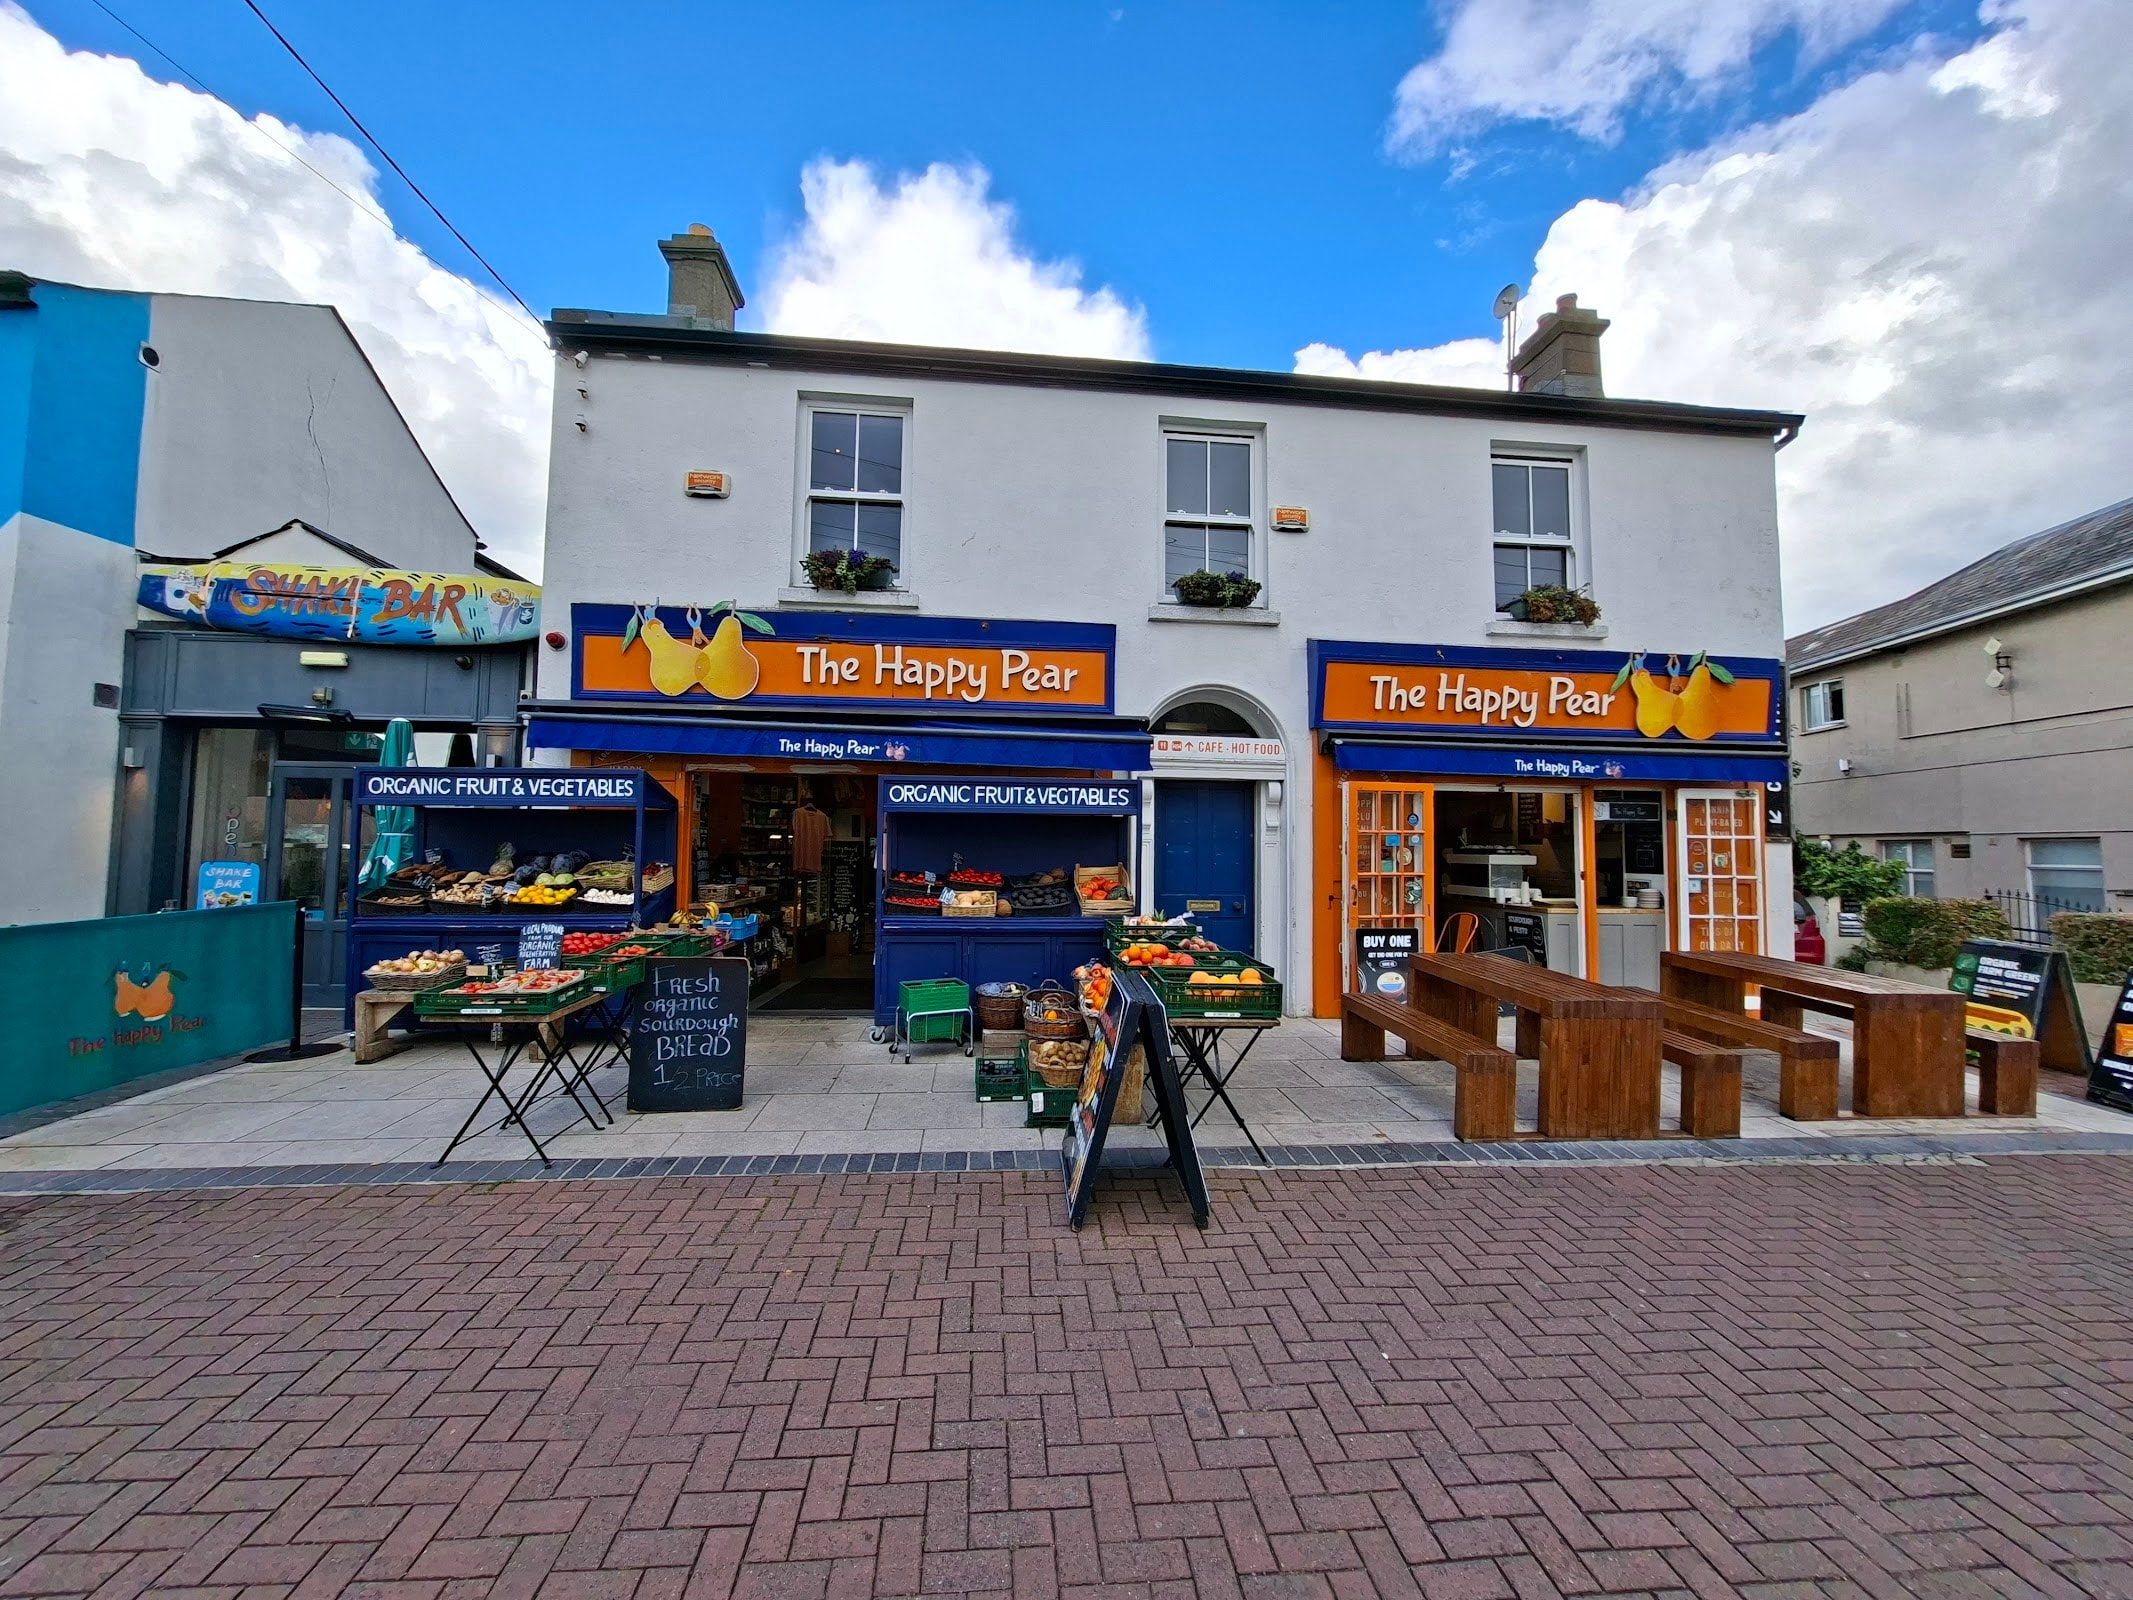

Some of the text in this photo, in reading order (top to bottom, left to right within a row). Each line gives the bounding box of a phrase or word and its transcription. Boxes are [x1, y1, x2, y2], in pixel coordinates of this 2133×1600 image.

[230, 568, 468, 637] SHAKE BAR
[796, 644, 1079, 702] The Happy Pear
[1370, 673, 1616, 728] The Happy Pear
[779, 739, 801, 752] The
[805, 739, 844, 759] Happy
[1198, 741, 1280, 755] CAFE HOT FOOD
[1515, 759, 1533, 772] The
[1536, 759, 1570, 777] Happy
[368, 777, 451, 795] ORGANIC
[456, 778, 511, 796] FRUIT
[528, 778, 634, 797] VEGETABLES
[889, 784, 971, 803] ORGANIC
[206, 867, 252, 877] SHAKE
[215, 879, 242, 888] BAR
[522, 941, 556, 951] ORGANIC
[1363, 935, 1412, 948] BUY ONE
[524, 958, 550, 970] FARM
[1979, 957, 2021, 970] ORGANIC
[1977, 966, 2041, 983] FARM GREENS
[69, 1014, 207, 1056] The Happy Pear
